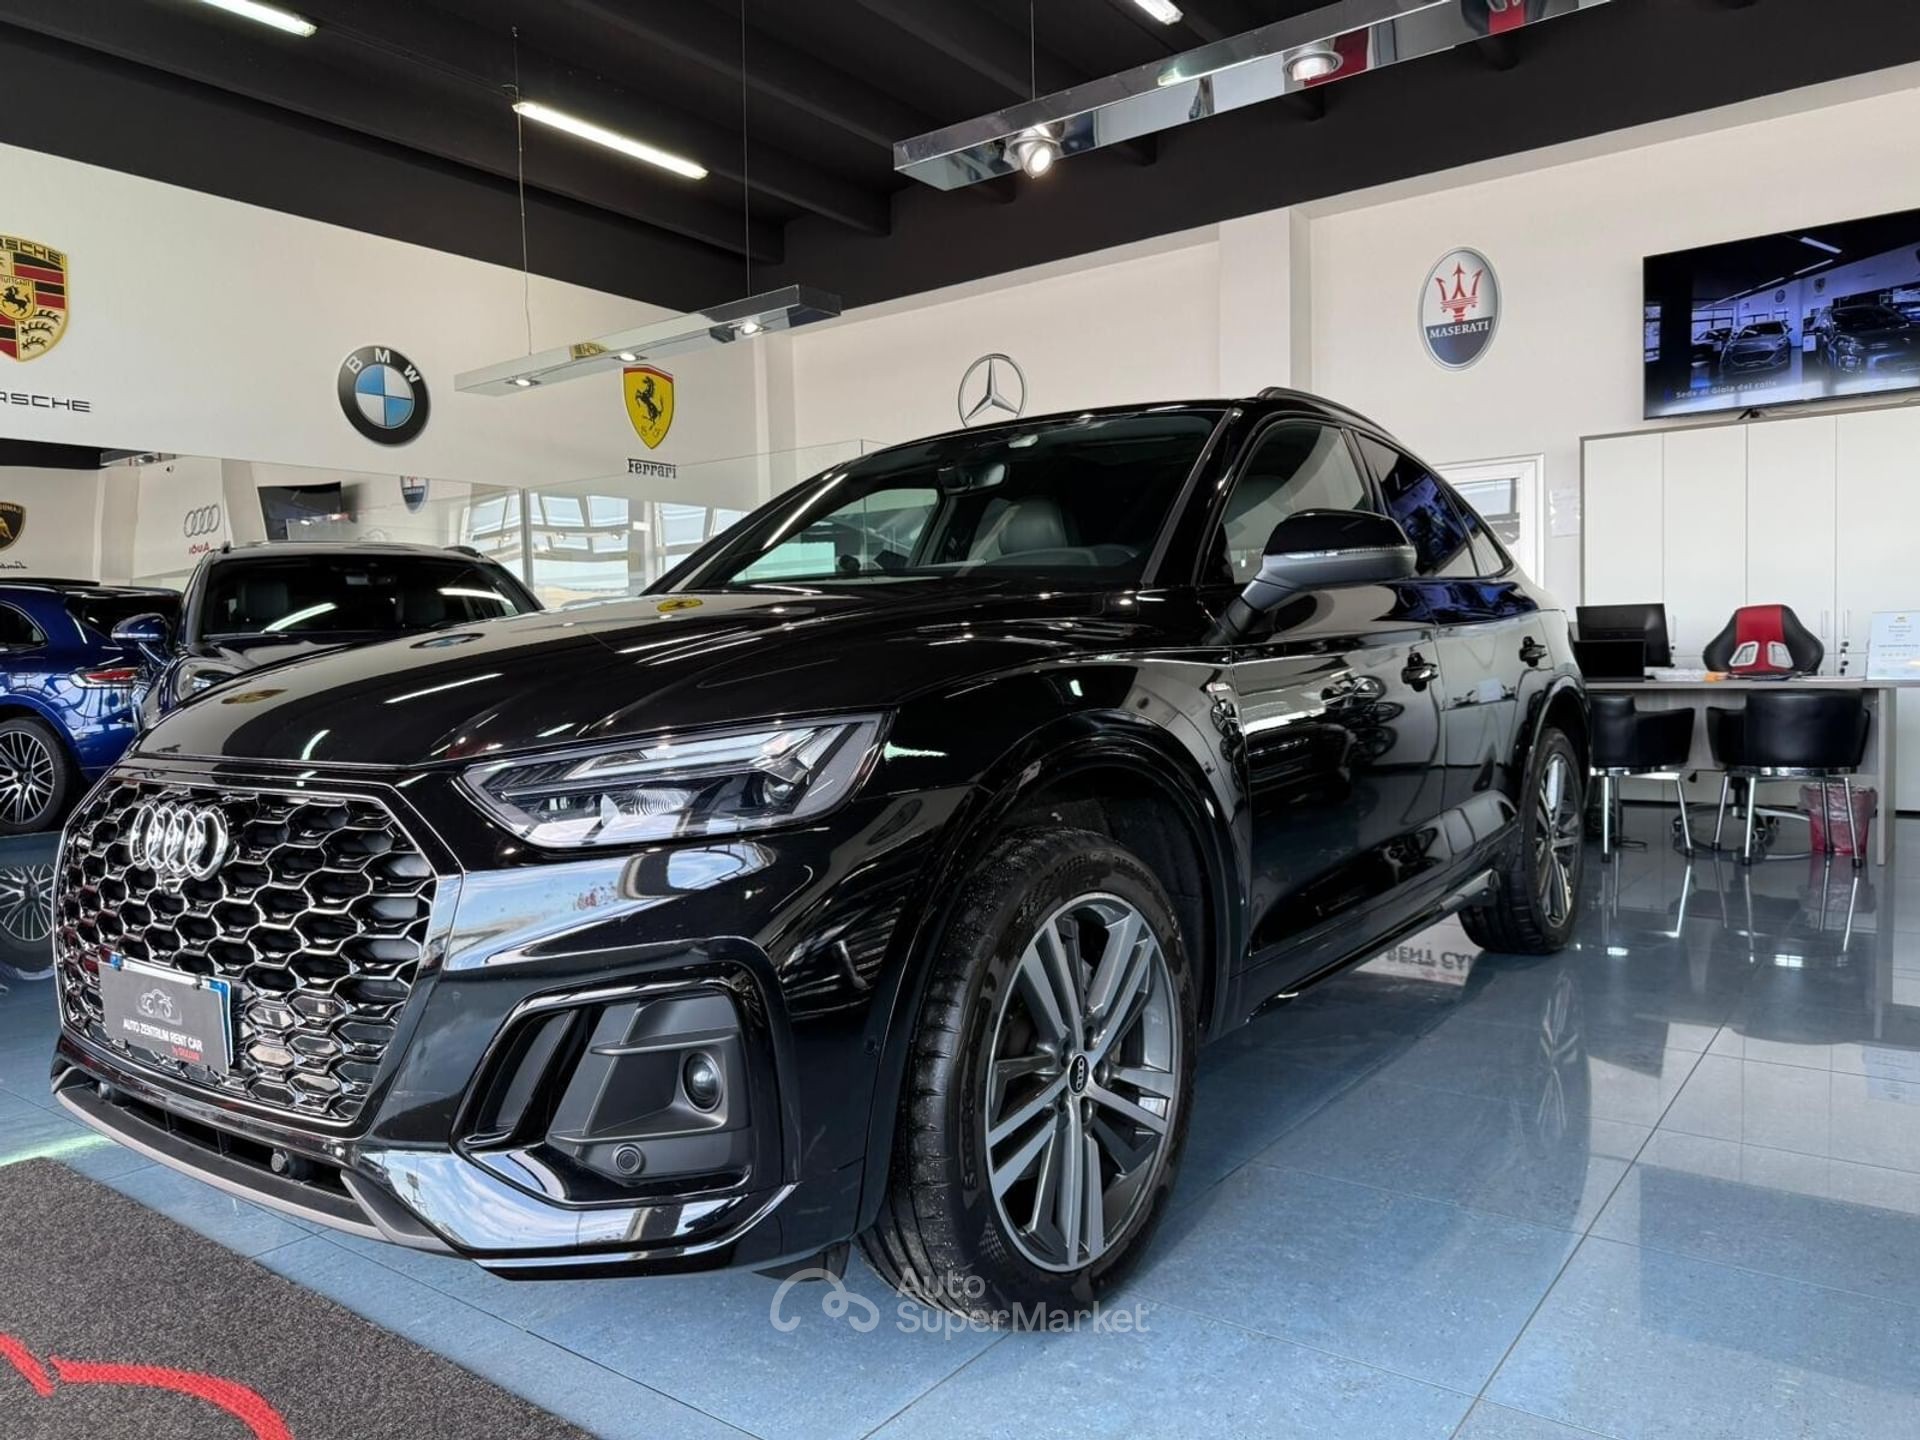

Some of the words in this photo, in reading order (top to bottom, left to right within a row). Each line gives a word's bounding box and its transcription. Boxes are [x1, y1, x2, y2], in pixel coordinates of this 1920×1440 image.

[1429, 320, 1489, 339] MASERATI
[345, 347, 420, 383] BMW
[627, 458, 677, 479] Ferrari
[123, 1018, 140, 1032] AUTO
[169, 1031, 187, 1047] RENT
[188, 1036, 203, 1052] CAR
